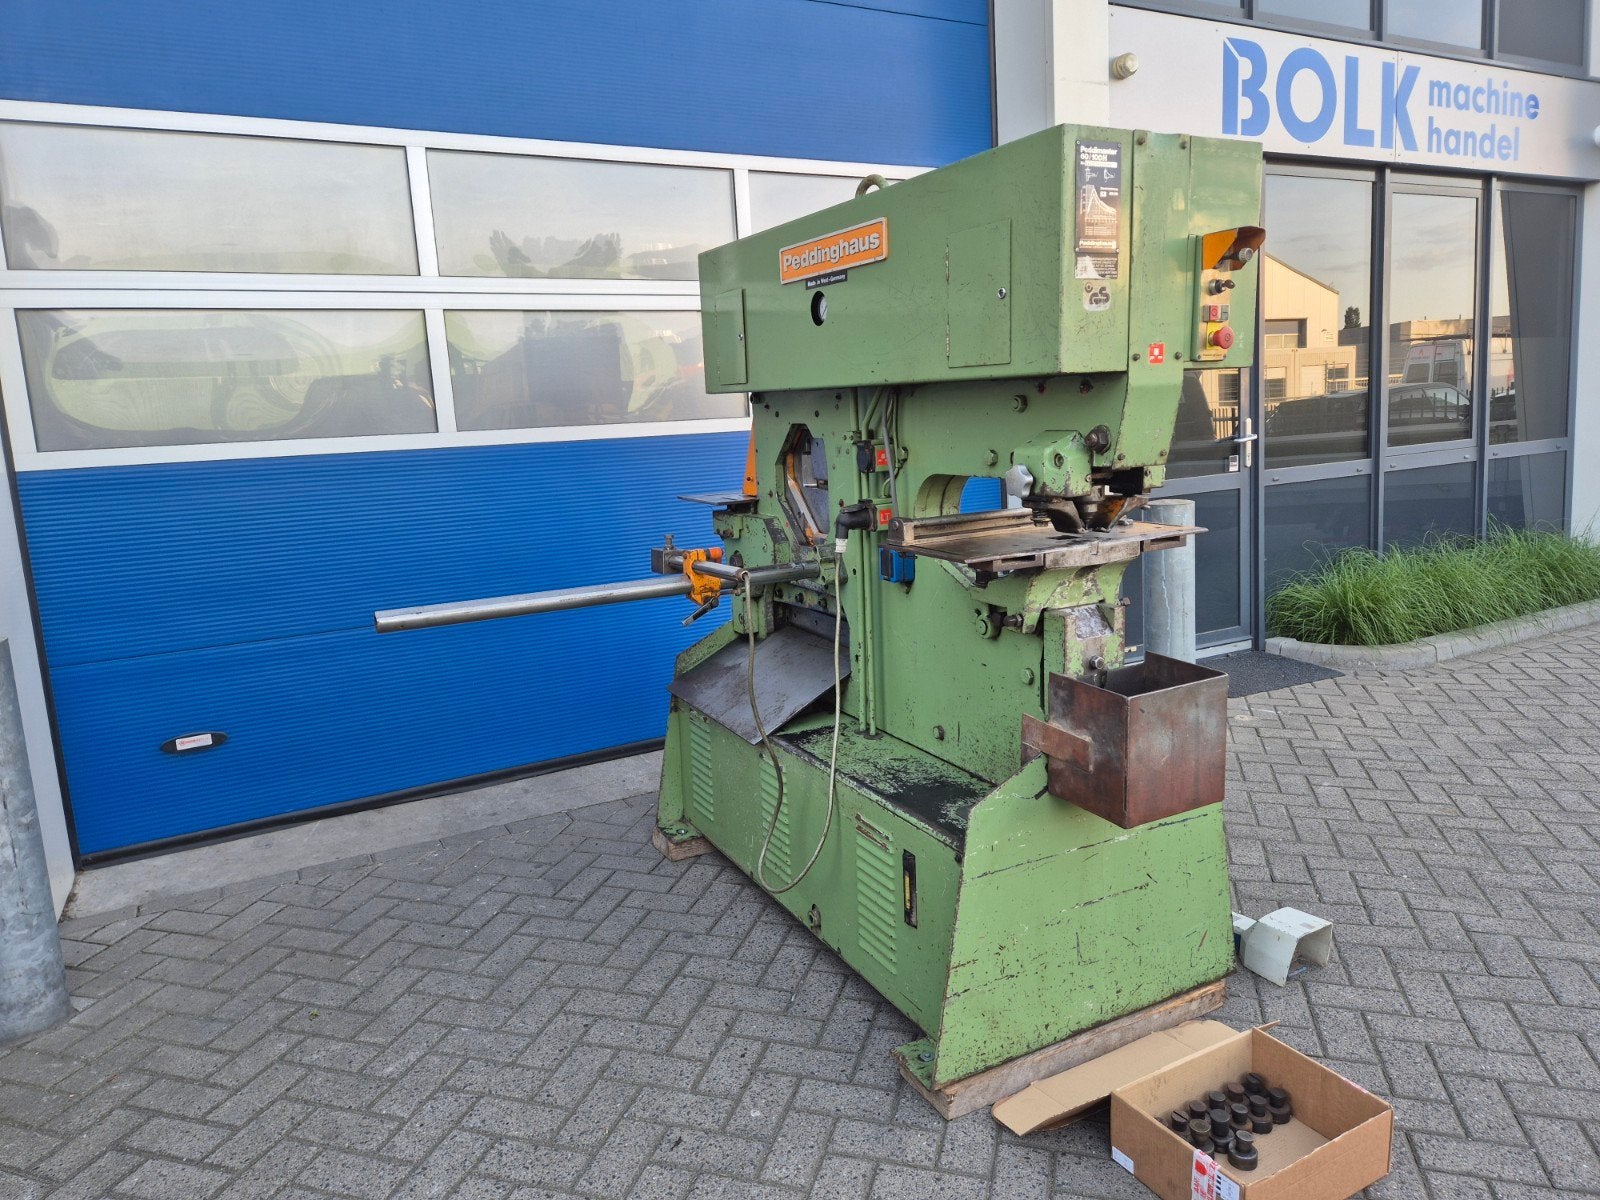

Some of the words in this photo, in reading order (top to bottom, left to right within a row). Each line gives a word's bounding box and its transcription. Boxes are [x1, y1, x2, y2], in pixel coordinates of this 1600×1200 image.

[1222, 37, 1421, 151] BOLK
[1428, 77, 1540, 120] machine
[1428, 116, 1520, 161] handel
[783, 232, 880, 272] Peddinghaus
